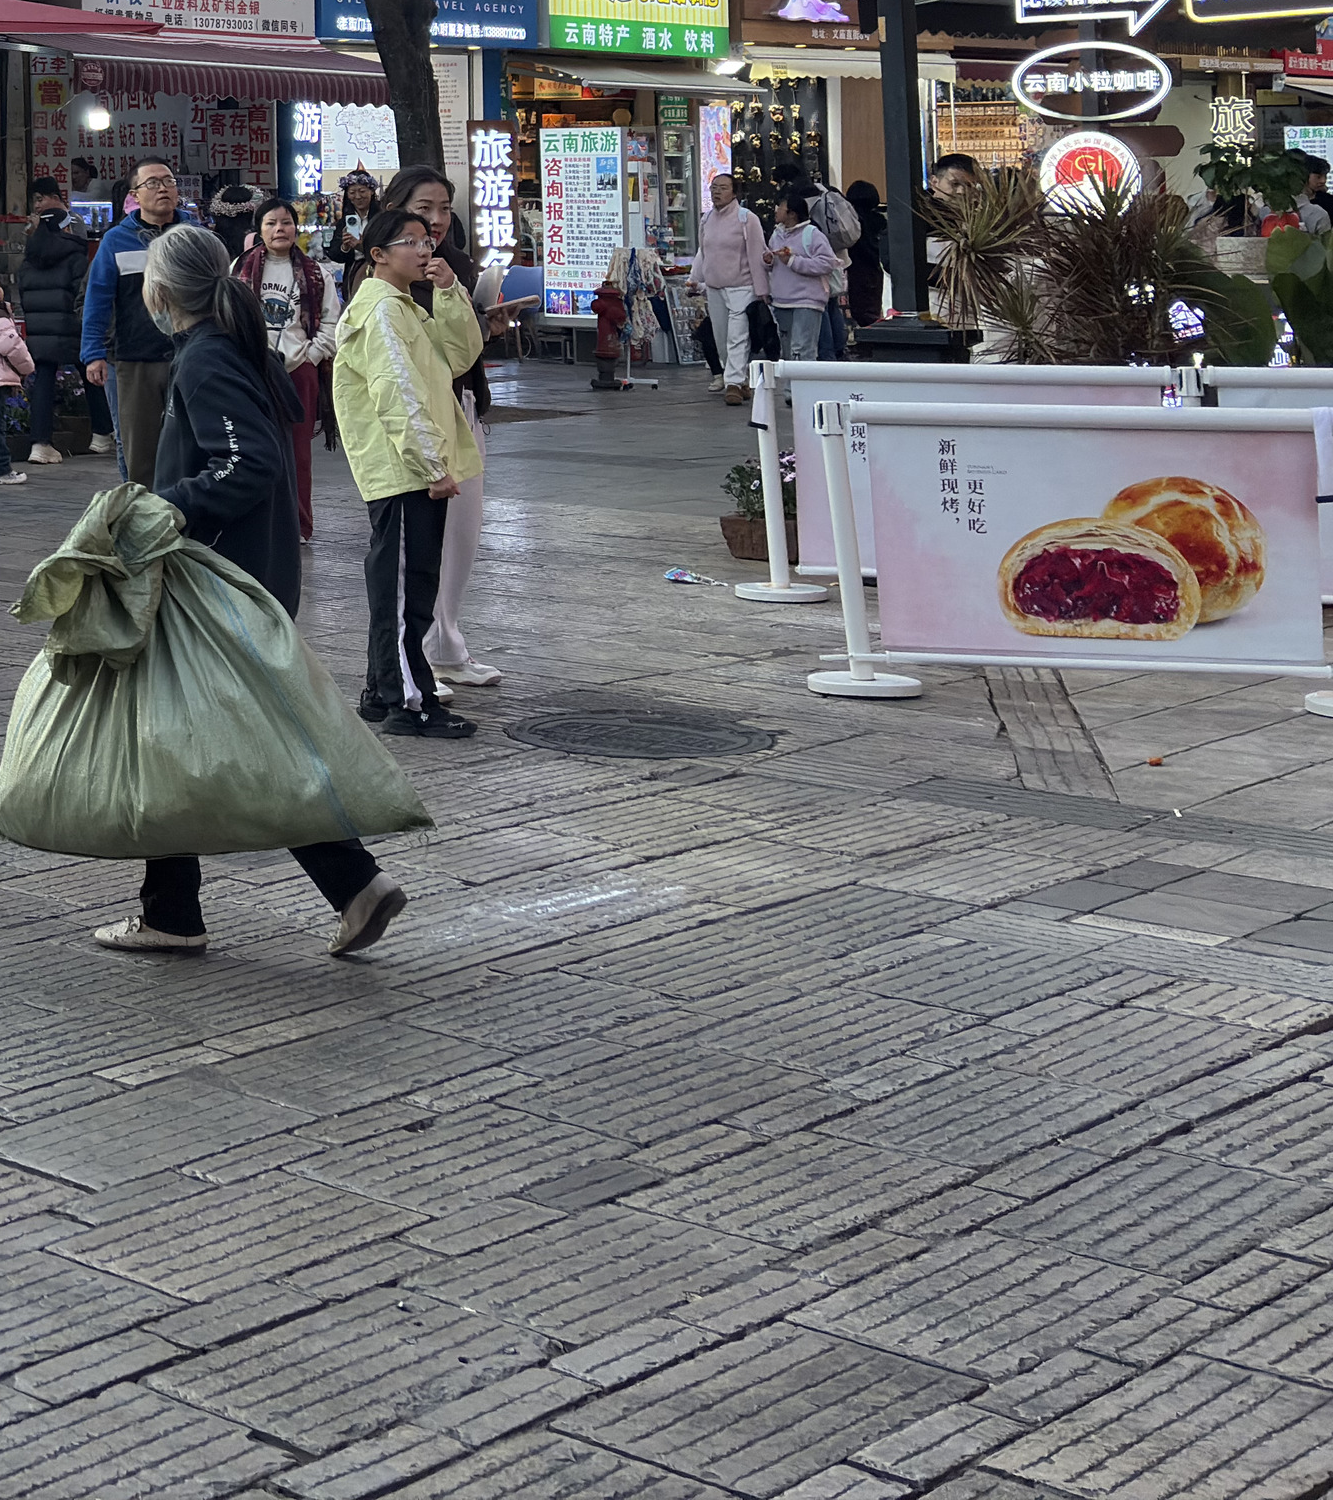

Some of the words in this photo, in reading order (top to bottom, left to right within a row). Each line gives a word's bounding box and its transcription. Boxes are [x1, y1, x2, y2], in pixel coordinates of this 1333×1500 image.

[475, 3, 524, 15] AGENCY
[193, 17, 253, 31] 13078793003
[564, 21, 630, 48] 云南特产
[642, 26, 673, 50] 酒水
[684, 29, 715, 53] 饮料
[32, 56, 67, 73] 行李
[39, 81, 64, 105] 當
[1024, 71, 1161, 93] 云南小粒咖啡
[34, 110, 68, 131] 回收
[209, 111, 250, 138] 寄存
[119, 124, 135, 148] 钻石
[140, 122, 157, 148] 玉器
[162, 121, 179, 148] 彩宝
[543, 131, 618, 153] 云南旅游
[33, 136, 68, 158] 黄金
[210, 143, 250, 169] 行李
[34, 162, 69, 185] 铂金
[1074, 154, 1102, 172] GI
[544, 157, 565, 266] 咨询报名处
[262, 282, 287, 293] ORNIA
[966, 479, 988, 534] 更好吃
